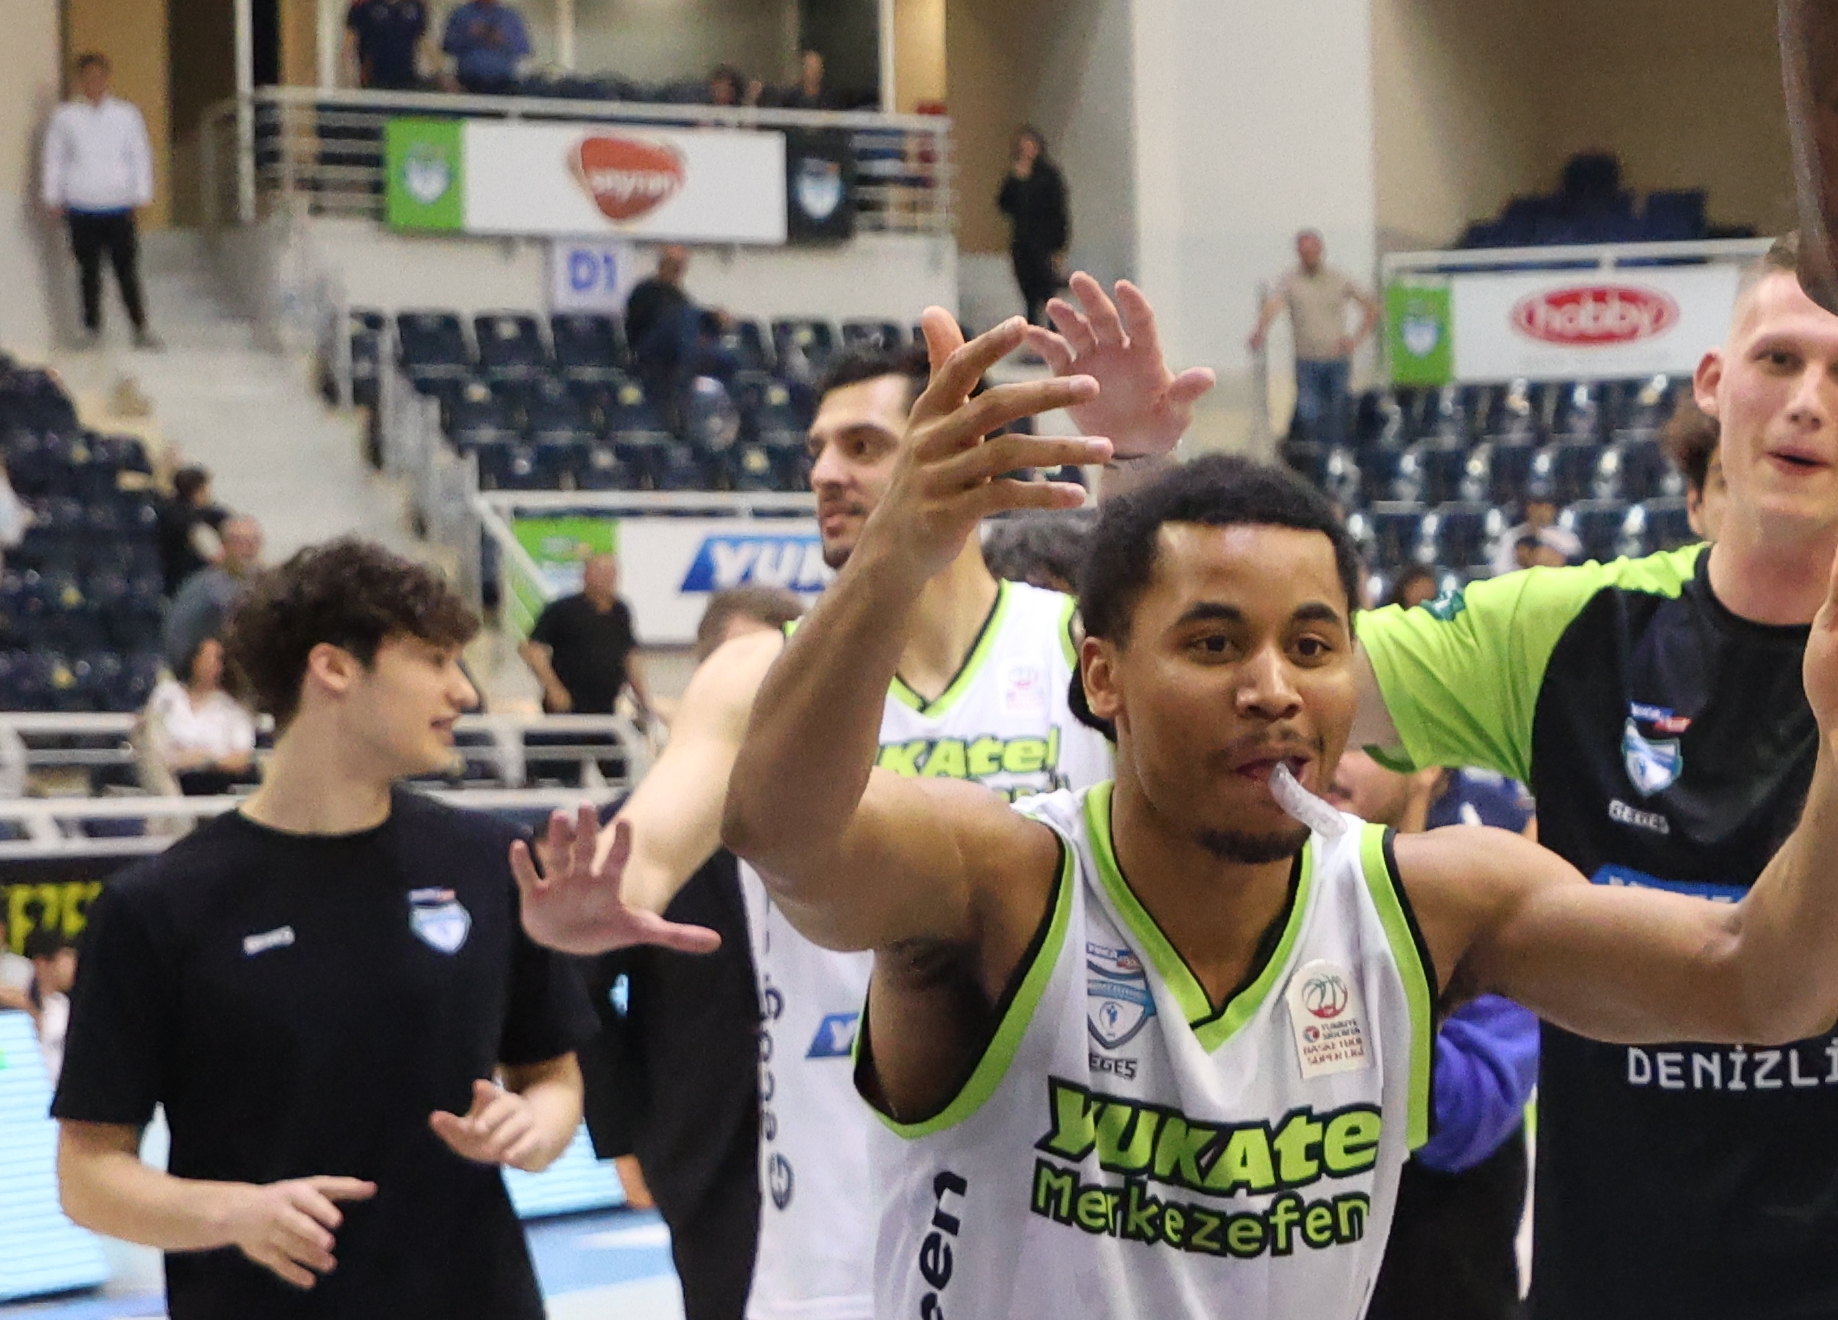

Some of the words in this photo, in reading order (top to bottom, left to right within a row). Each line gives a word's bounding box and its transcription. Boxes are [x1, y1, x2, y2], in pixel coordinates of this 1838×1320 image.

[567, 249, 620, 293] D1
[1536, 289, 1656, 343] hobby
[1089, 1051, 1138, 1080] EGES
